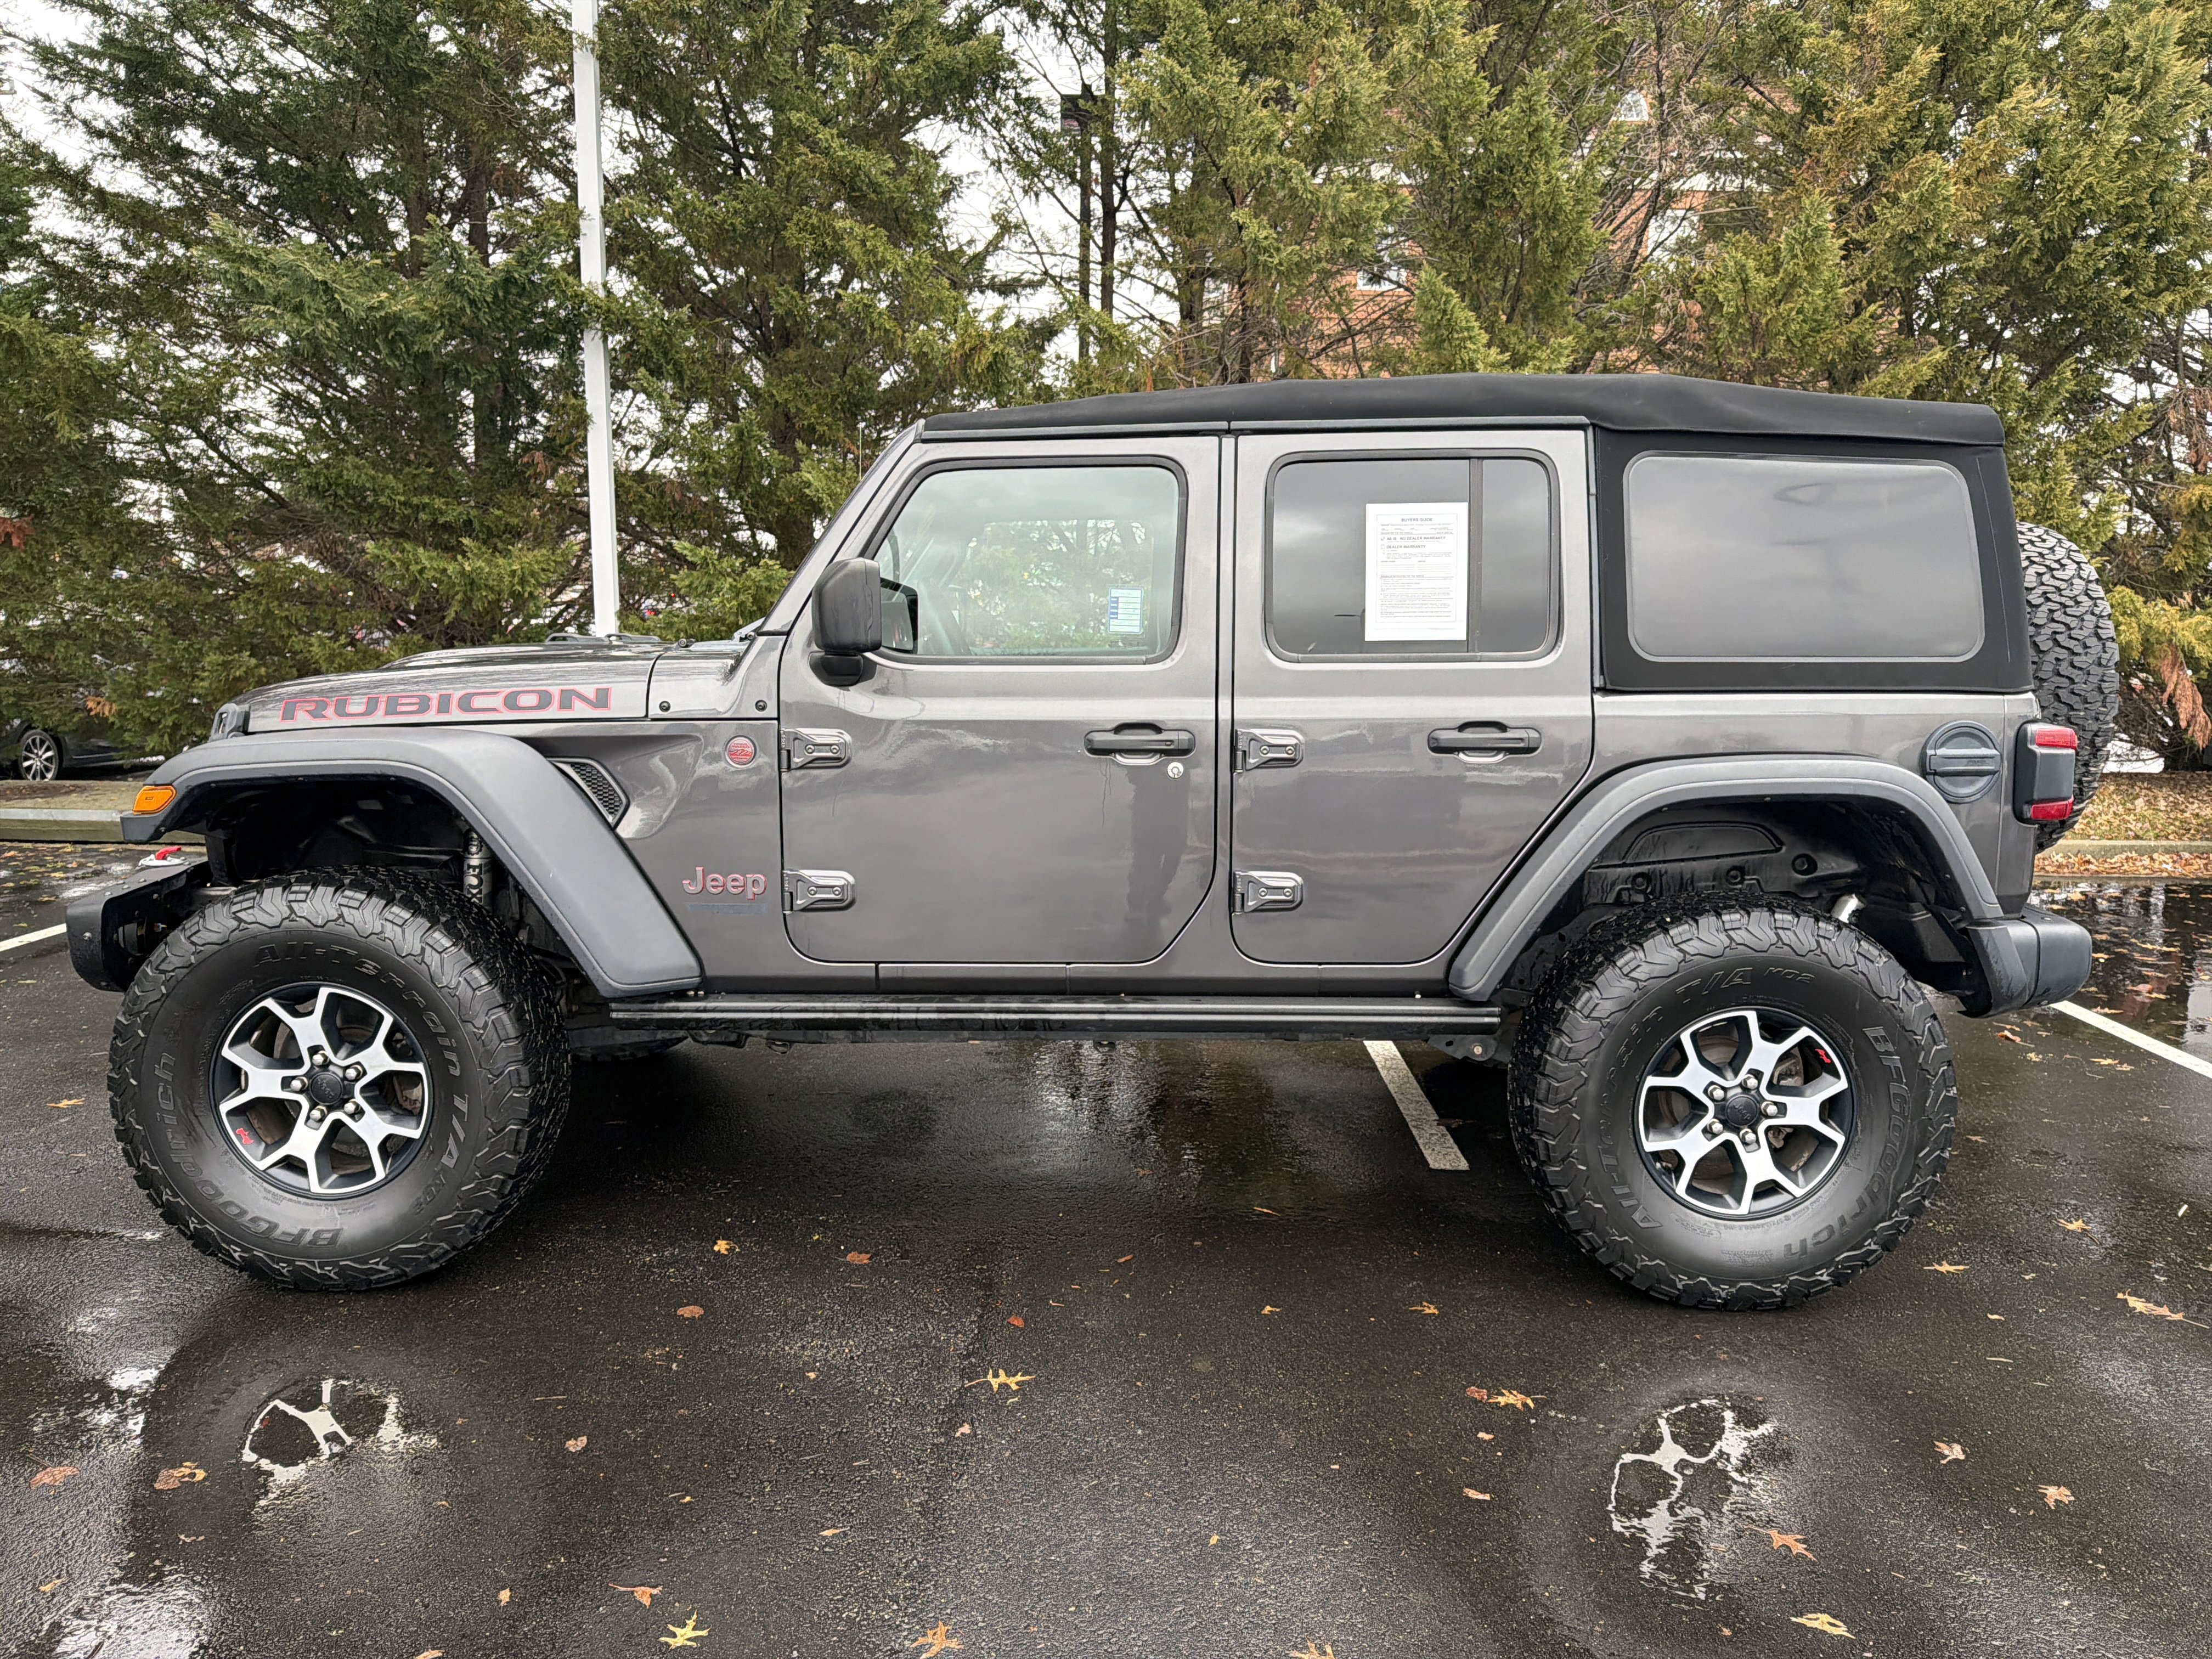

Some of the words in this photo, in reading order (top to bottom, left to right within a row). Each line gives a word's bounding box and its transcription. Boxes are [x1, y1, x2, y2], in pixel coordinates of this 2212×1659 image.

[280, 687, 612, 723] RUBICON
[682, 866, 767, 900] Jeep
[154, 1052, 343, 1248] BFGoodrich
[1782, 1026, 1912, 1260] BFGoodrich
